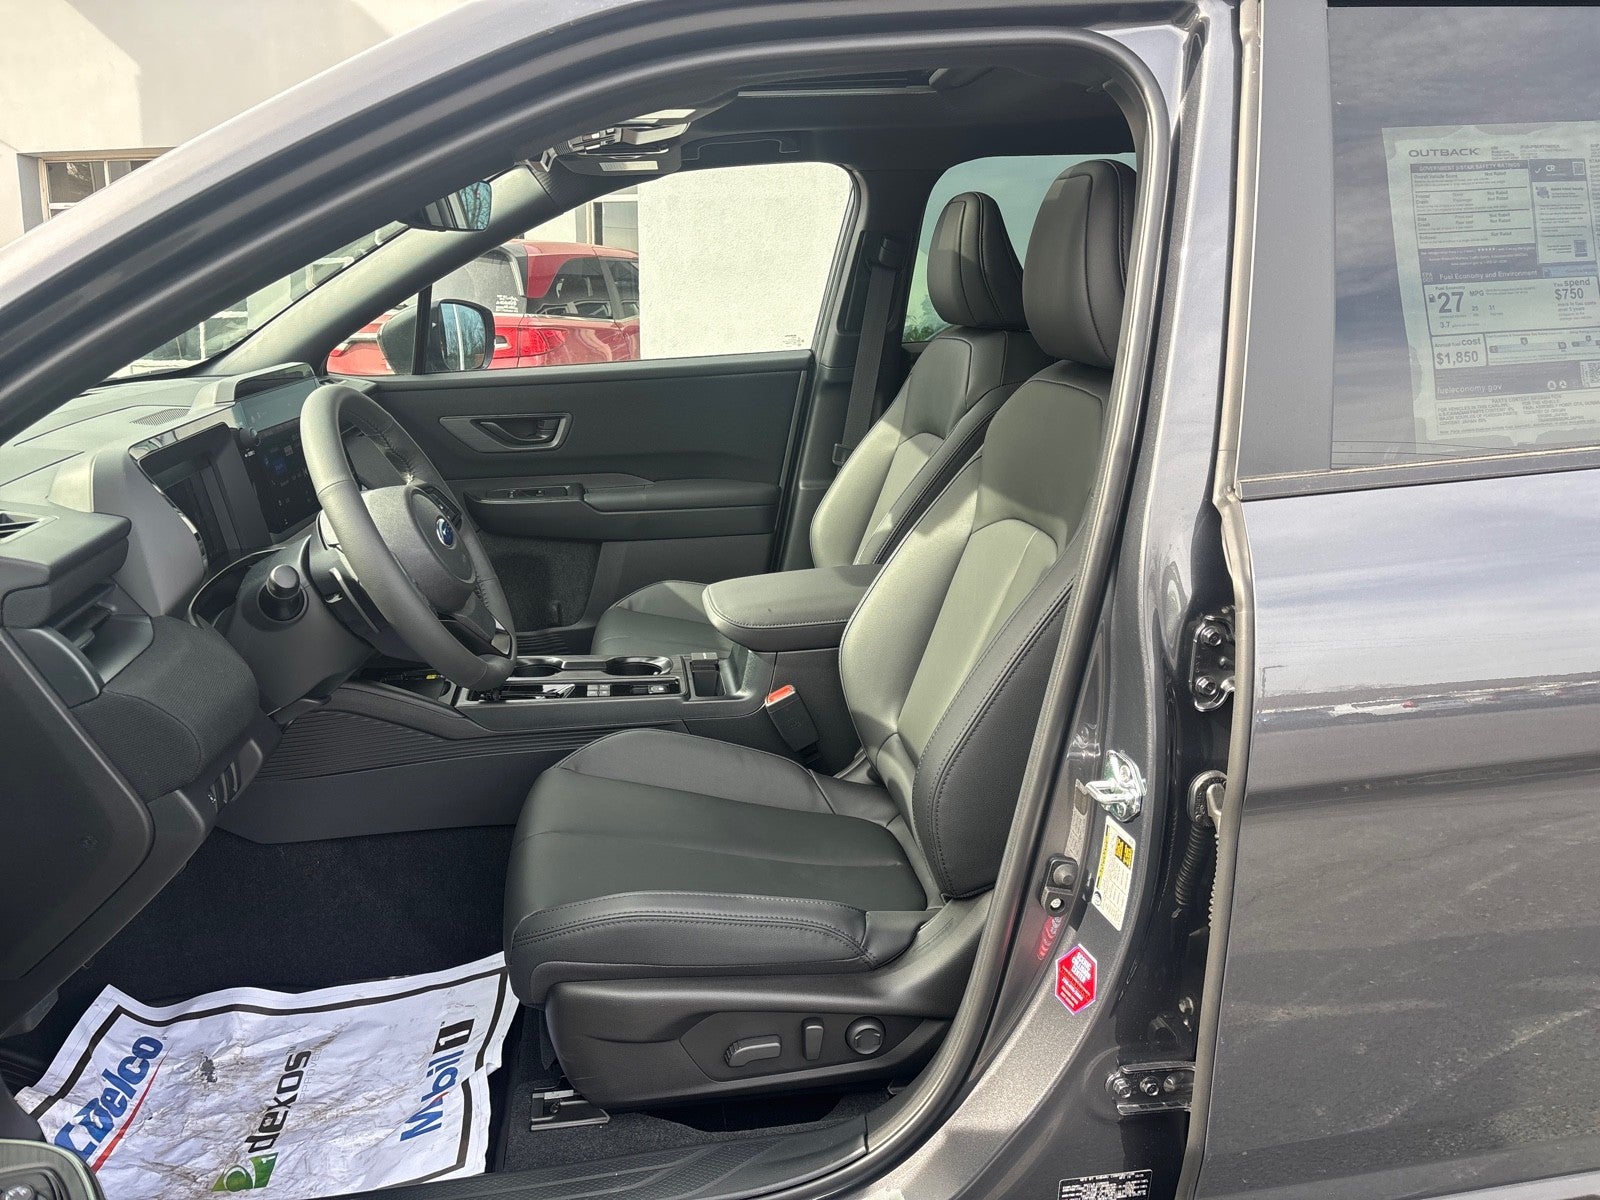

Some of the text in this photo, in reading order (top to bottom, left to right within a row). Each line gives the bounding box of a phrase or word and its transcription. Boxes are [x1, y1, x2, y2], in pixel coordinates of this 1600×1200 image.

[1408, 147, 1481, 157] OUTBACK
[1455, 272, 1483, 280] Economy
[1564, 277, 1590, 288] spend
[1554, 288, 1584, 300] $750
[1437, 291, 1464, 313] 27
[1461, 337, 1481, 346] cost
[1436, 350, 1479, 366] $1,850
[1437, 384, 1503, 394] fueleconomy.gov
[54, 1036, 164, 1162] CDelco
[399, 1049, 465, 1141] Mbil
[245, 1050, 312, 1153] dexos
